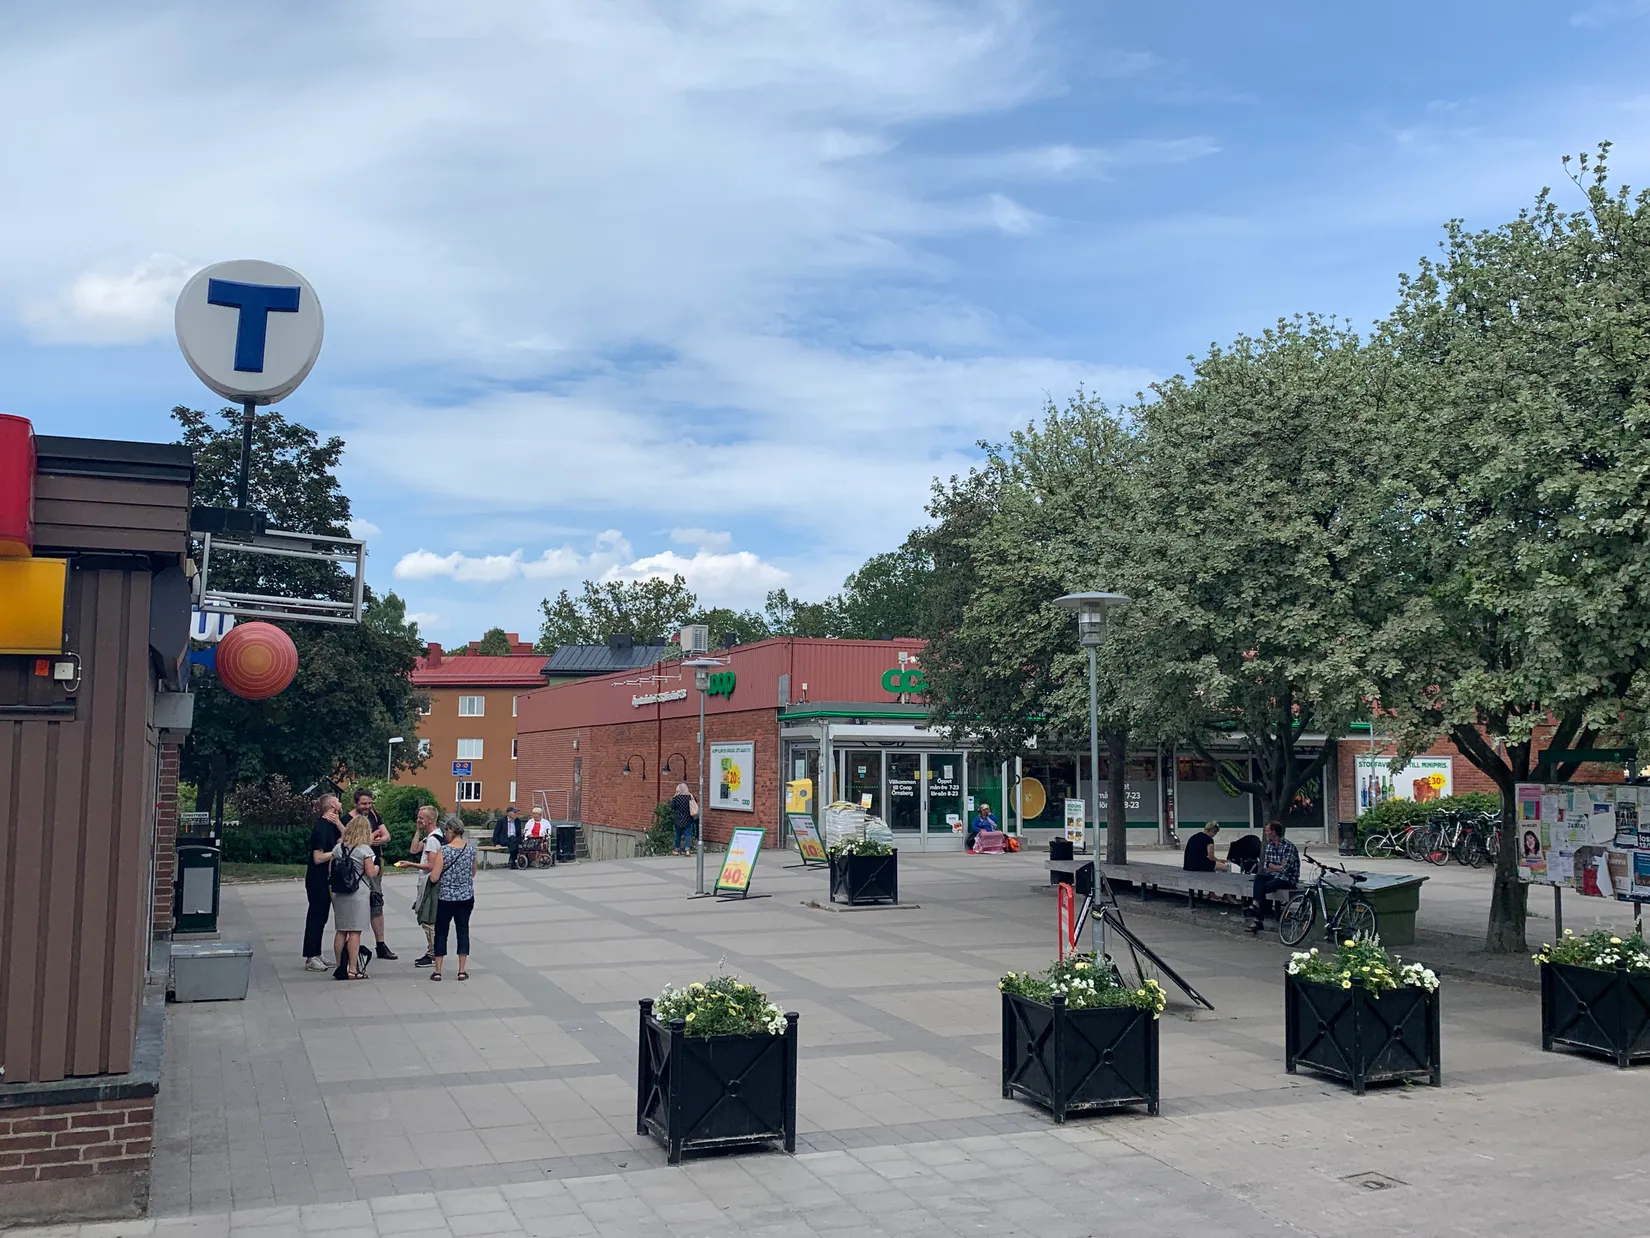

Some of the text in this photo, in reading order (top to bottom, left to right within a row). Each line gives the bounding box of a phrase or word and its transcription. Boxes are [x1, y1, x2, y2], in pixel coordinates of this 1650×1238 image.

[208, 278, 301, 373] T
[706, 671, 736, 699] oop
[936, 777, 952, 785] Öppet
[1125, 791, 1141, 799] 7-23
